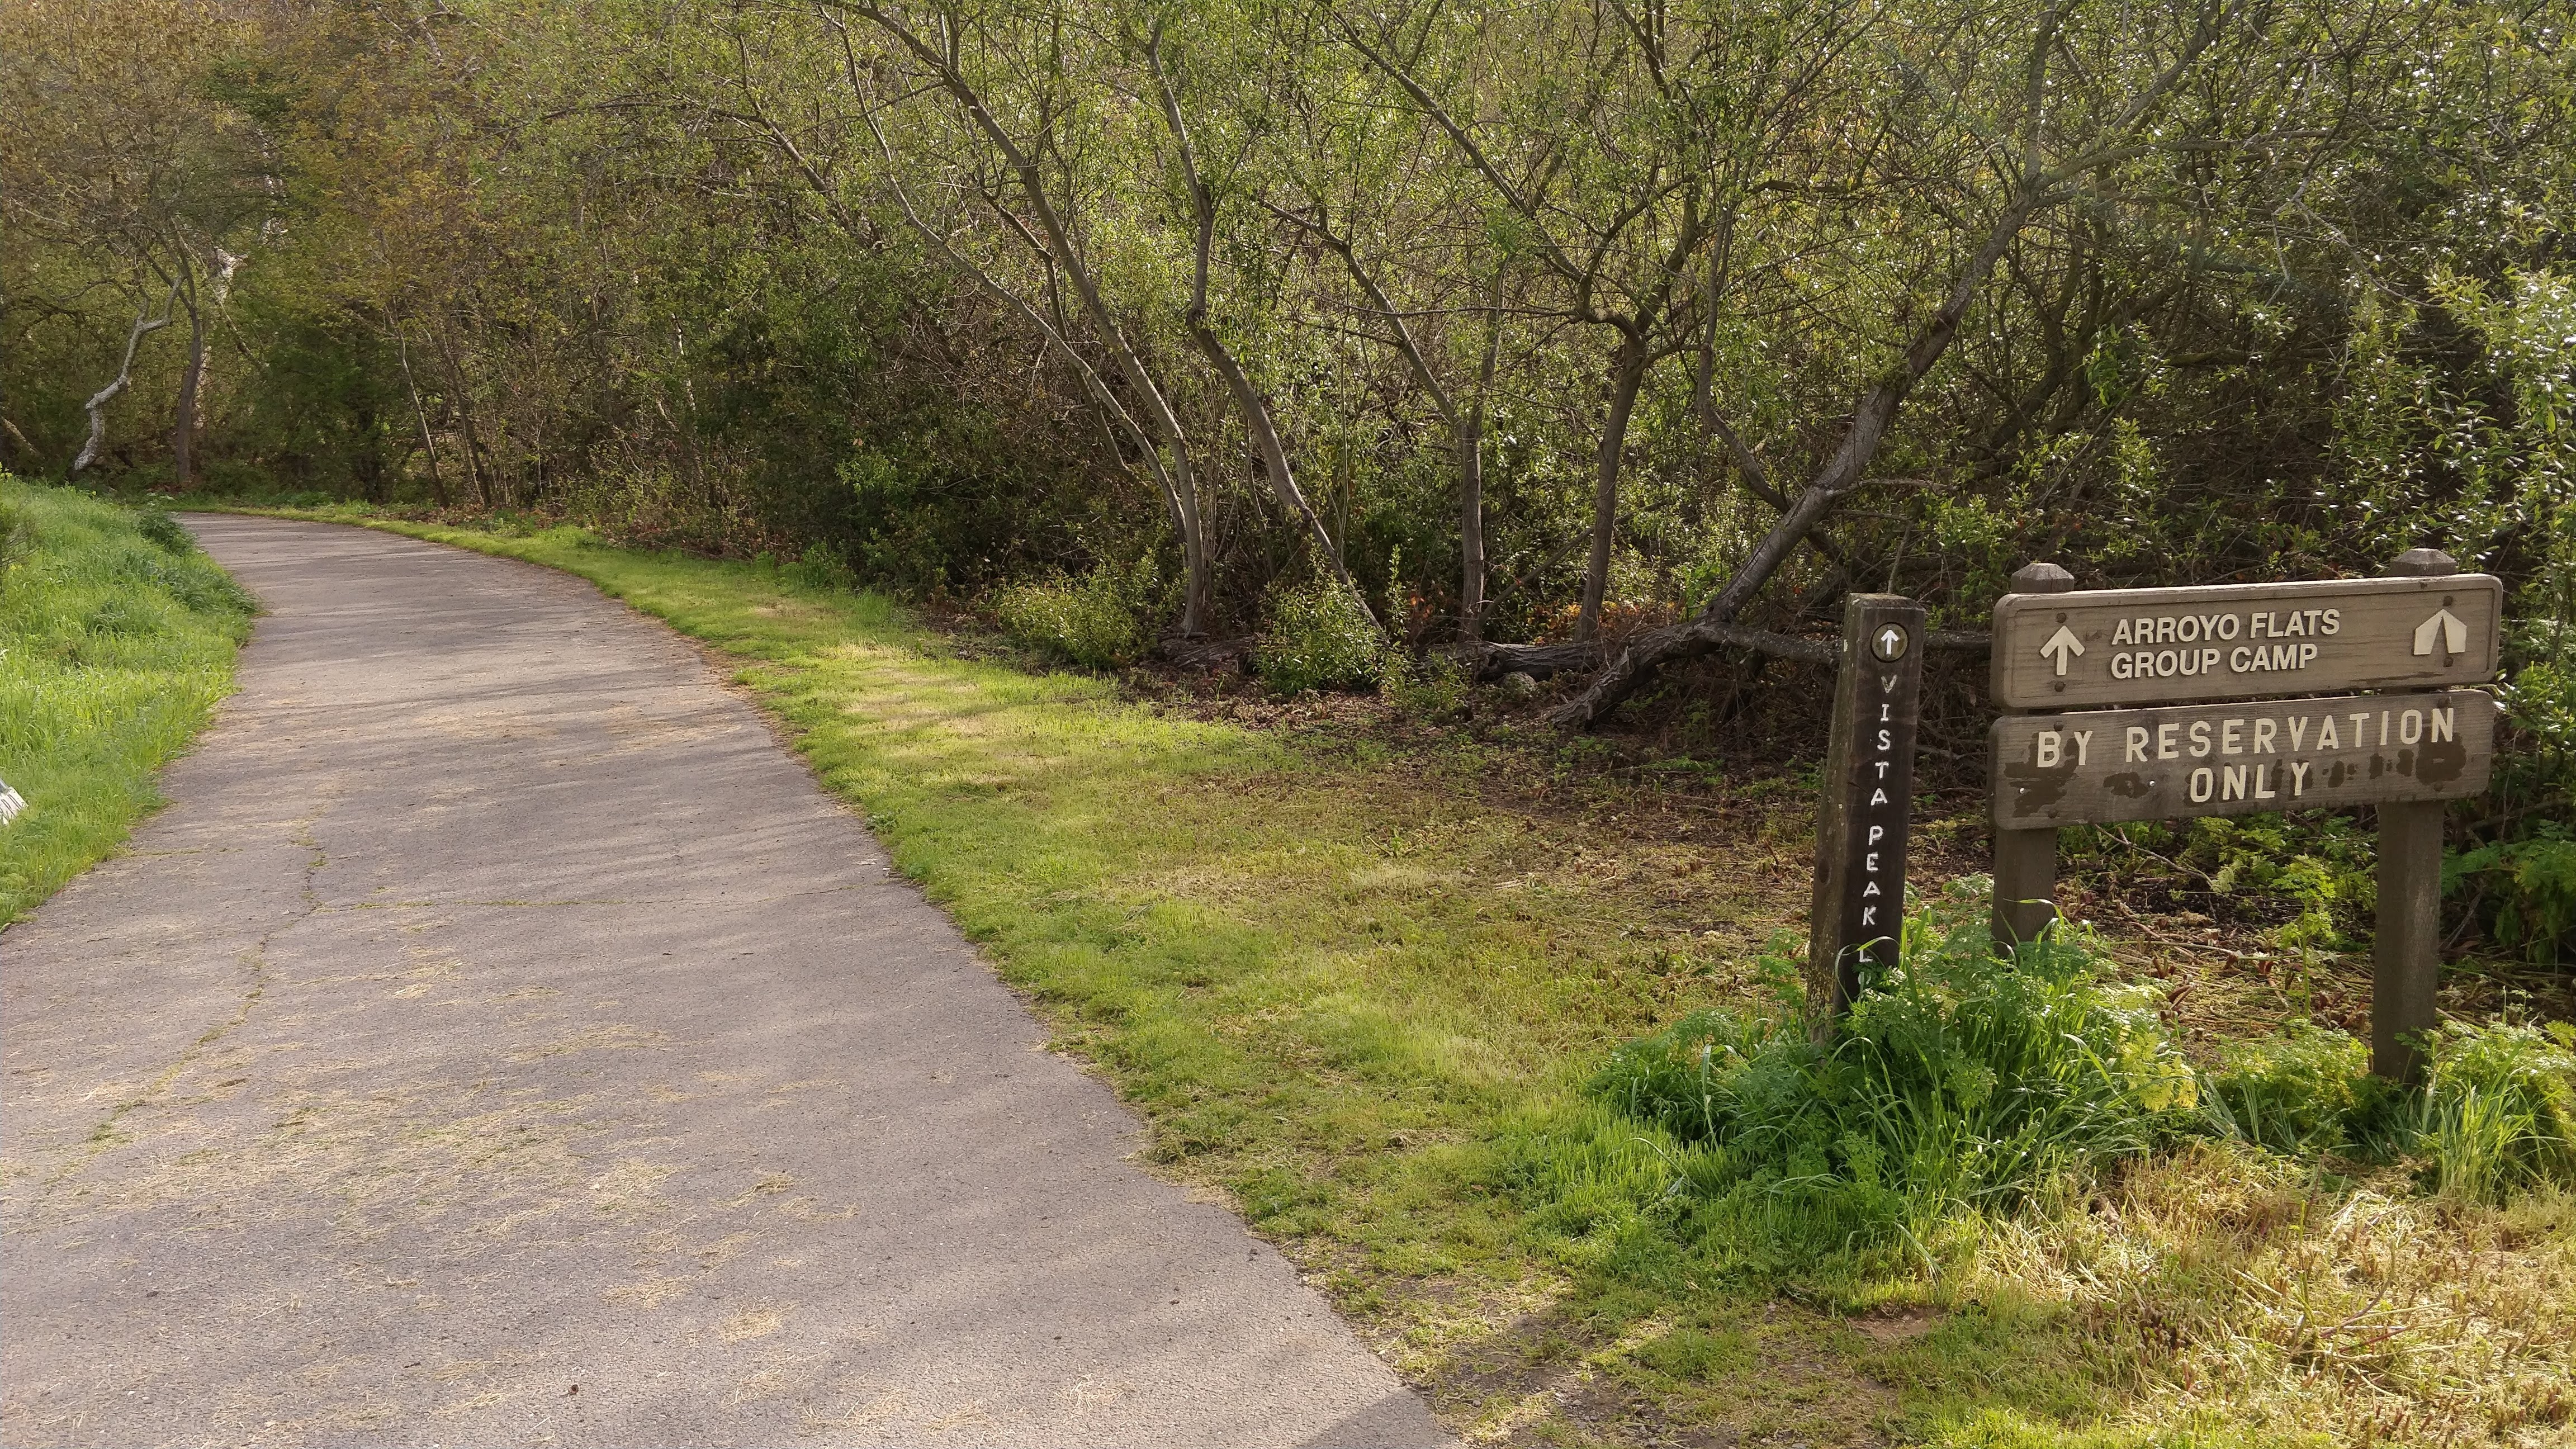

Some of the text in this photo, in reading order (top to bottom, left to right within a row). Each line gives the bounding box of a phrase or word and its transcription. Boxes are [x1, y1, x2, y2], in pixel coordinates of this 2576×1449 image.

[2111, 609, 2341, 646] ARROYO FLATS
[2111, 643, 2318, 679] GROUP CAMP
[1870, 674, 1897, 806] VISTA
[2037, 707, 2454, 768] BY RESERVATION
[2190, 761, 2310, 803] ONLY
[1862, 825, 1883, 926] PEAK
